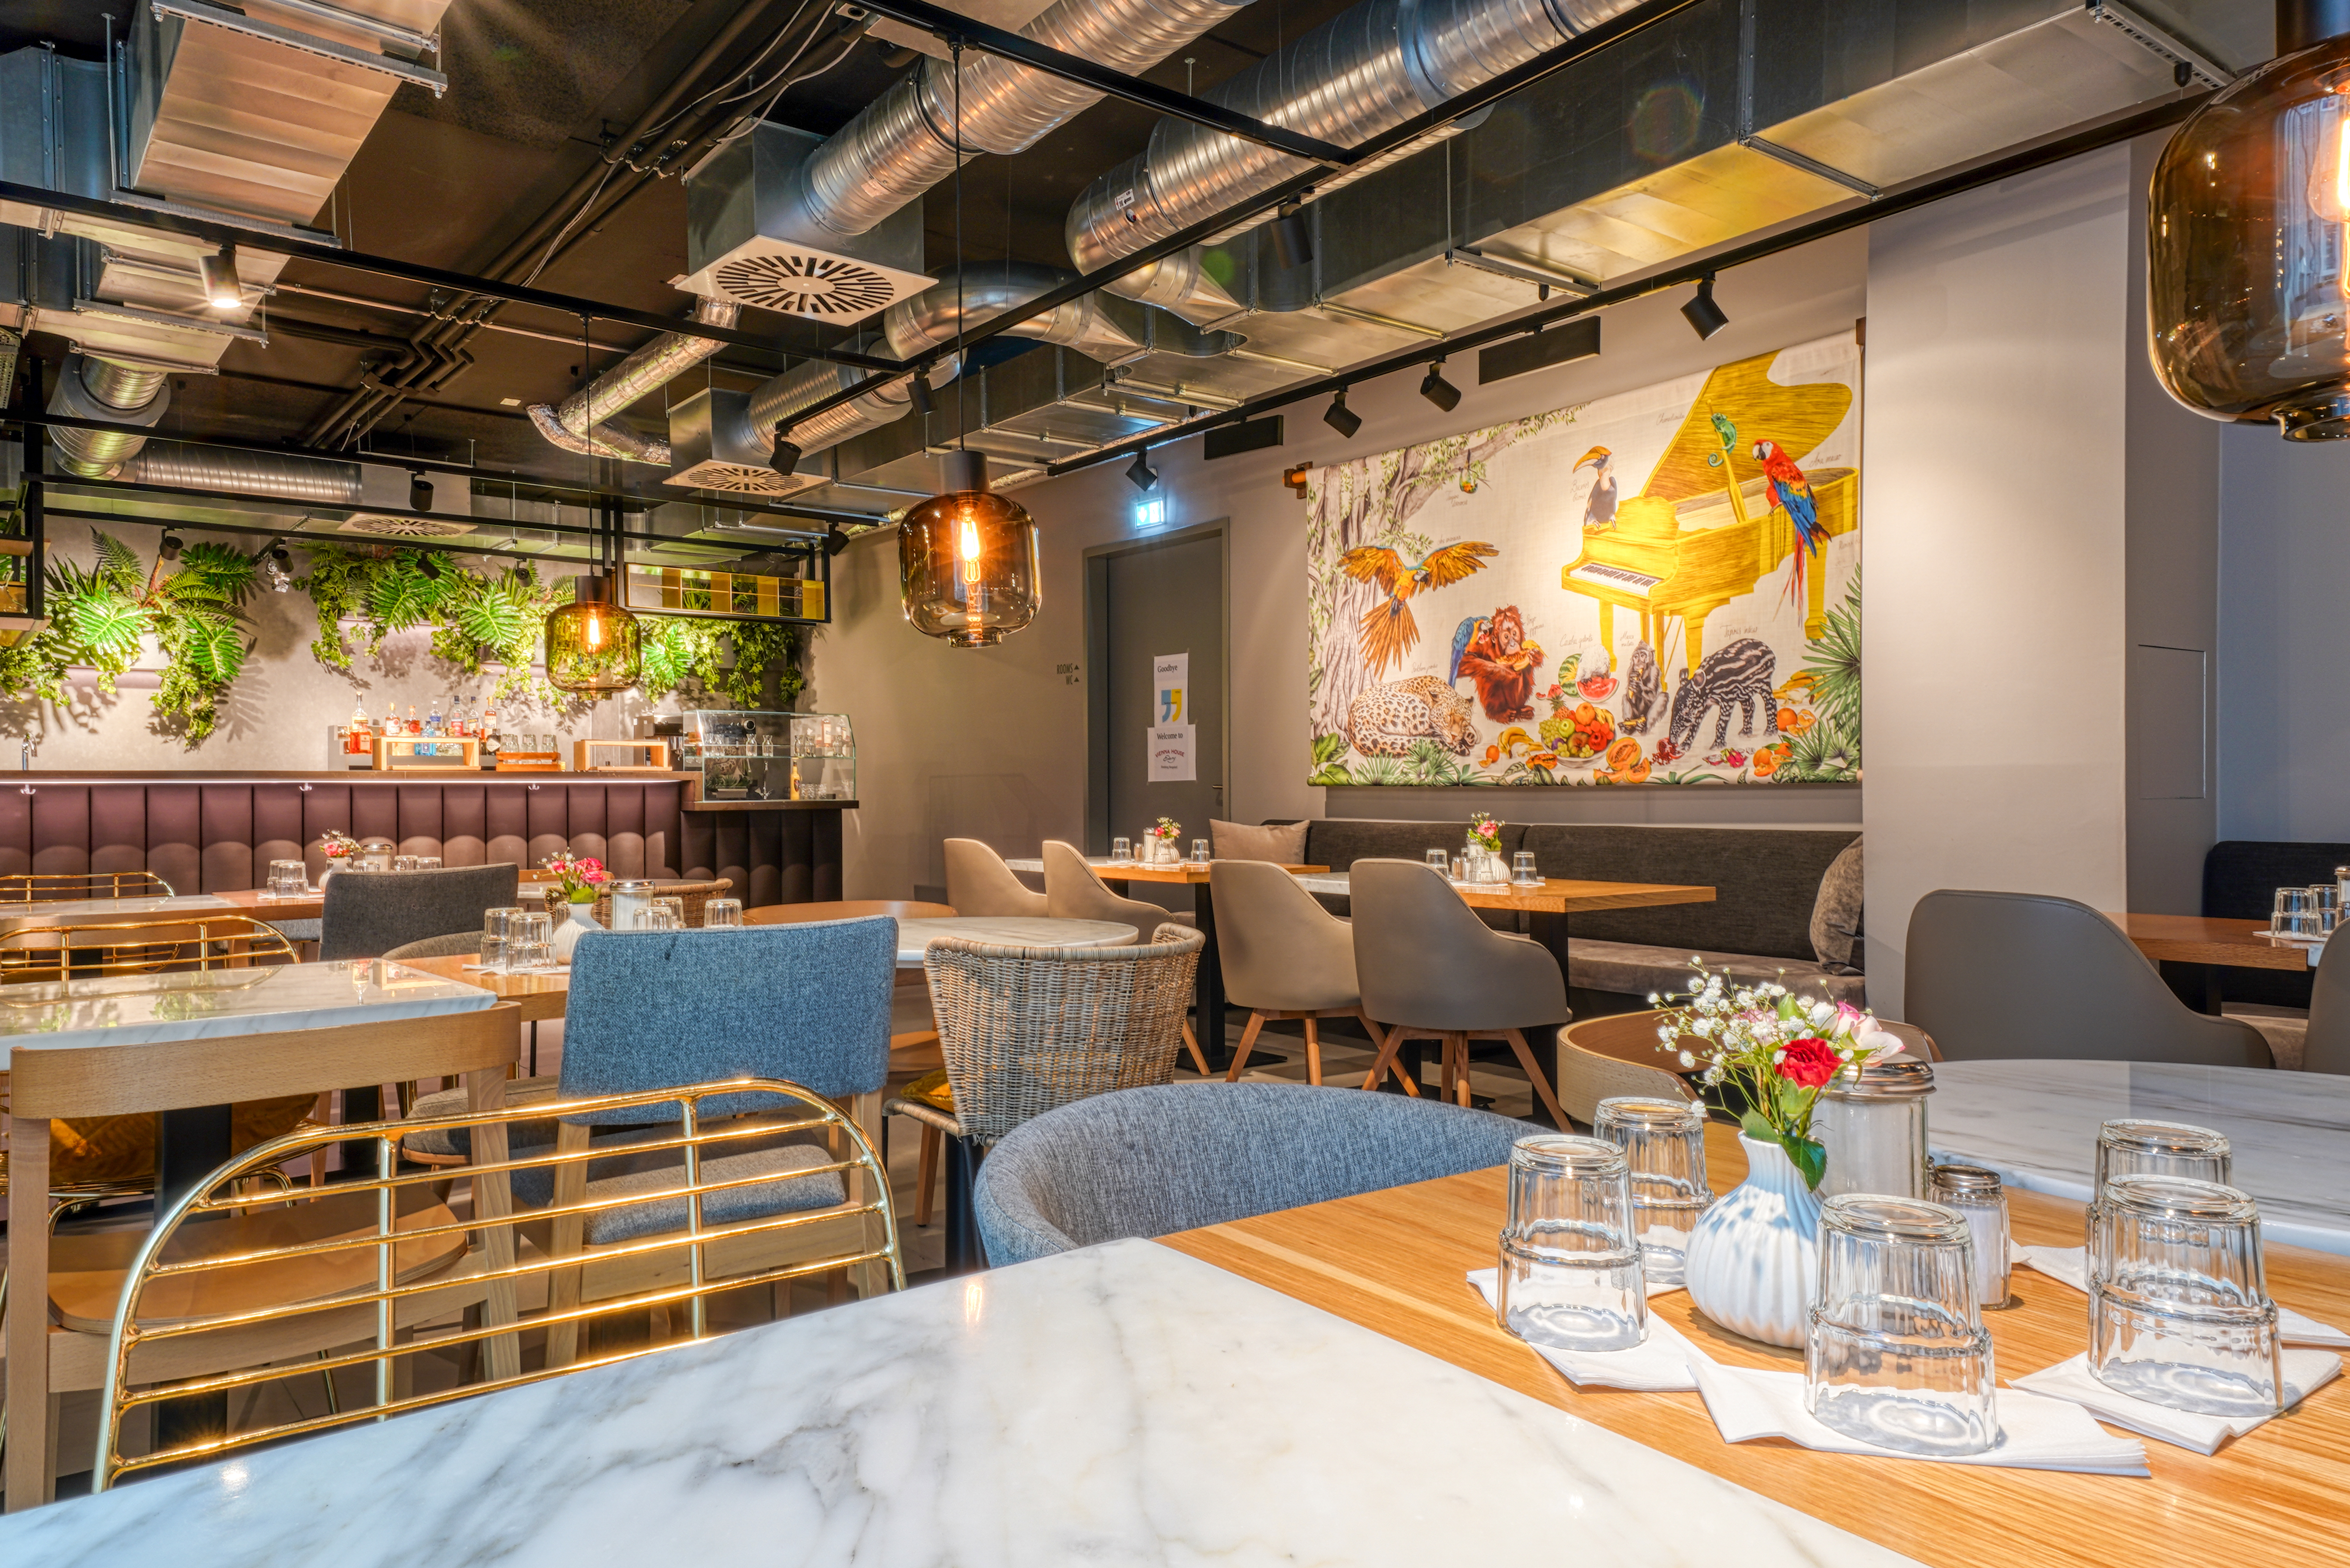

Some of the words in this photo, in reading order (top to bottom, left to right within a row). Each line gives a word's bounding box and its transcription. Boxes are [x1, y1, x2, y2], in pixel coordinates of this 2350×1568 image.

[1056, 663, 1073, 674] ROOMS
[1157, 664, 1178, 673] Goodbye
[1065, 674, 1073, 685] WC
[1156, 732, 1177, 740] Welcome
[1155, 749, 1170, 758] VIENNA
[1171, 749, 1185, 757] HOUSE
